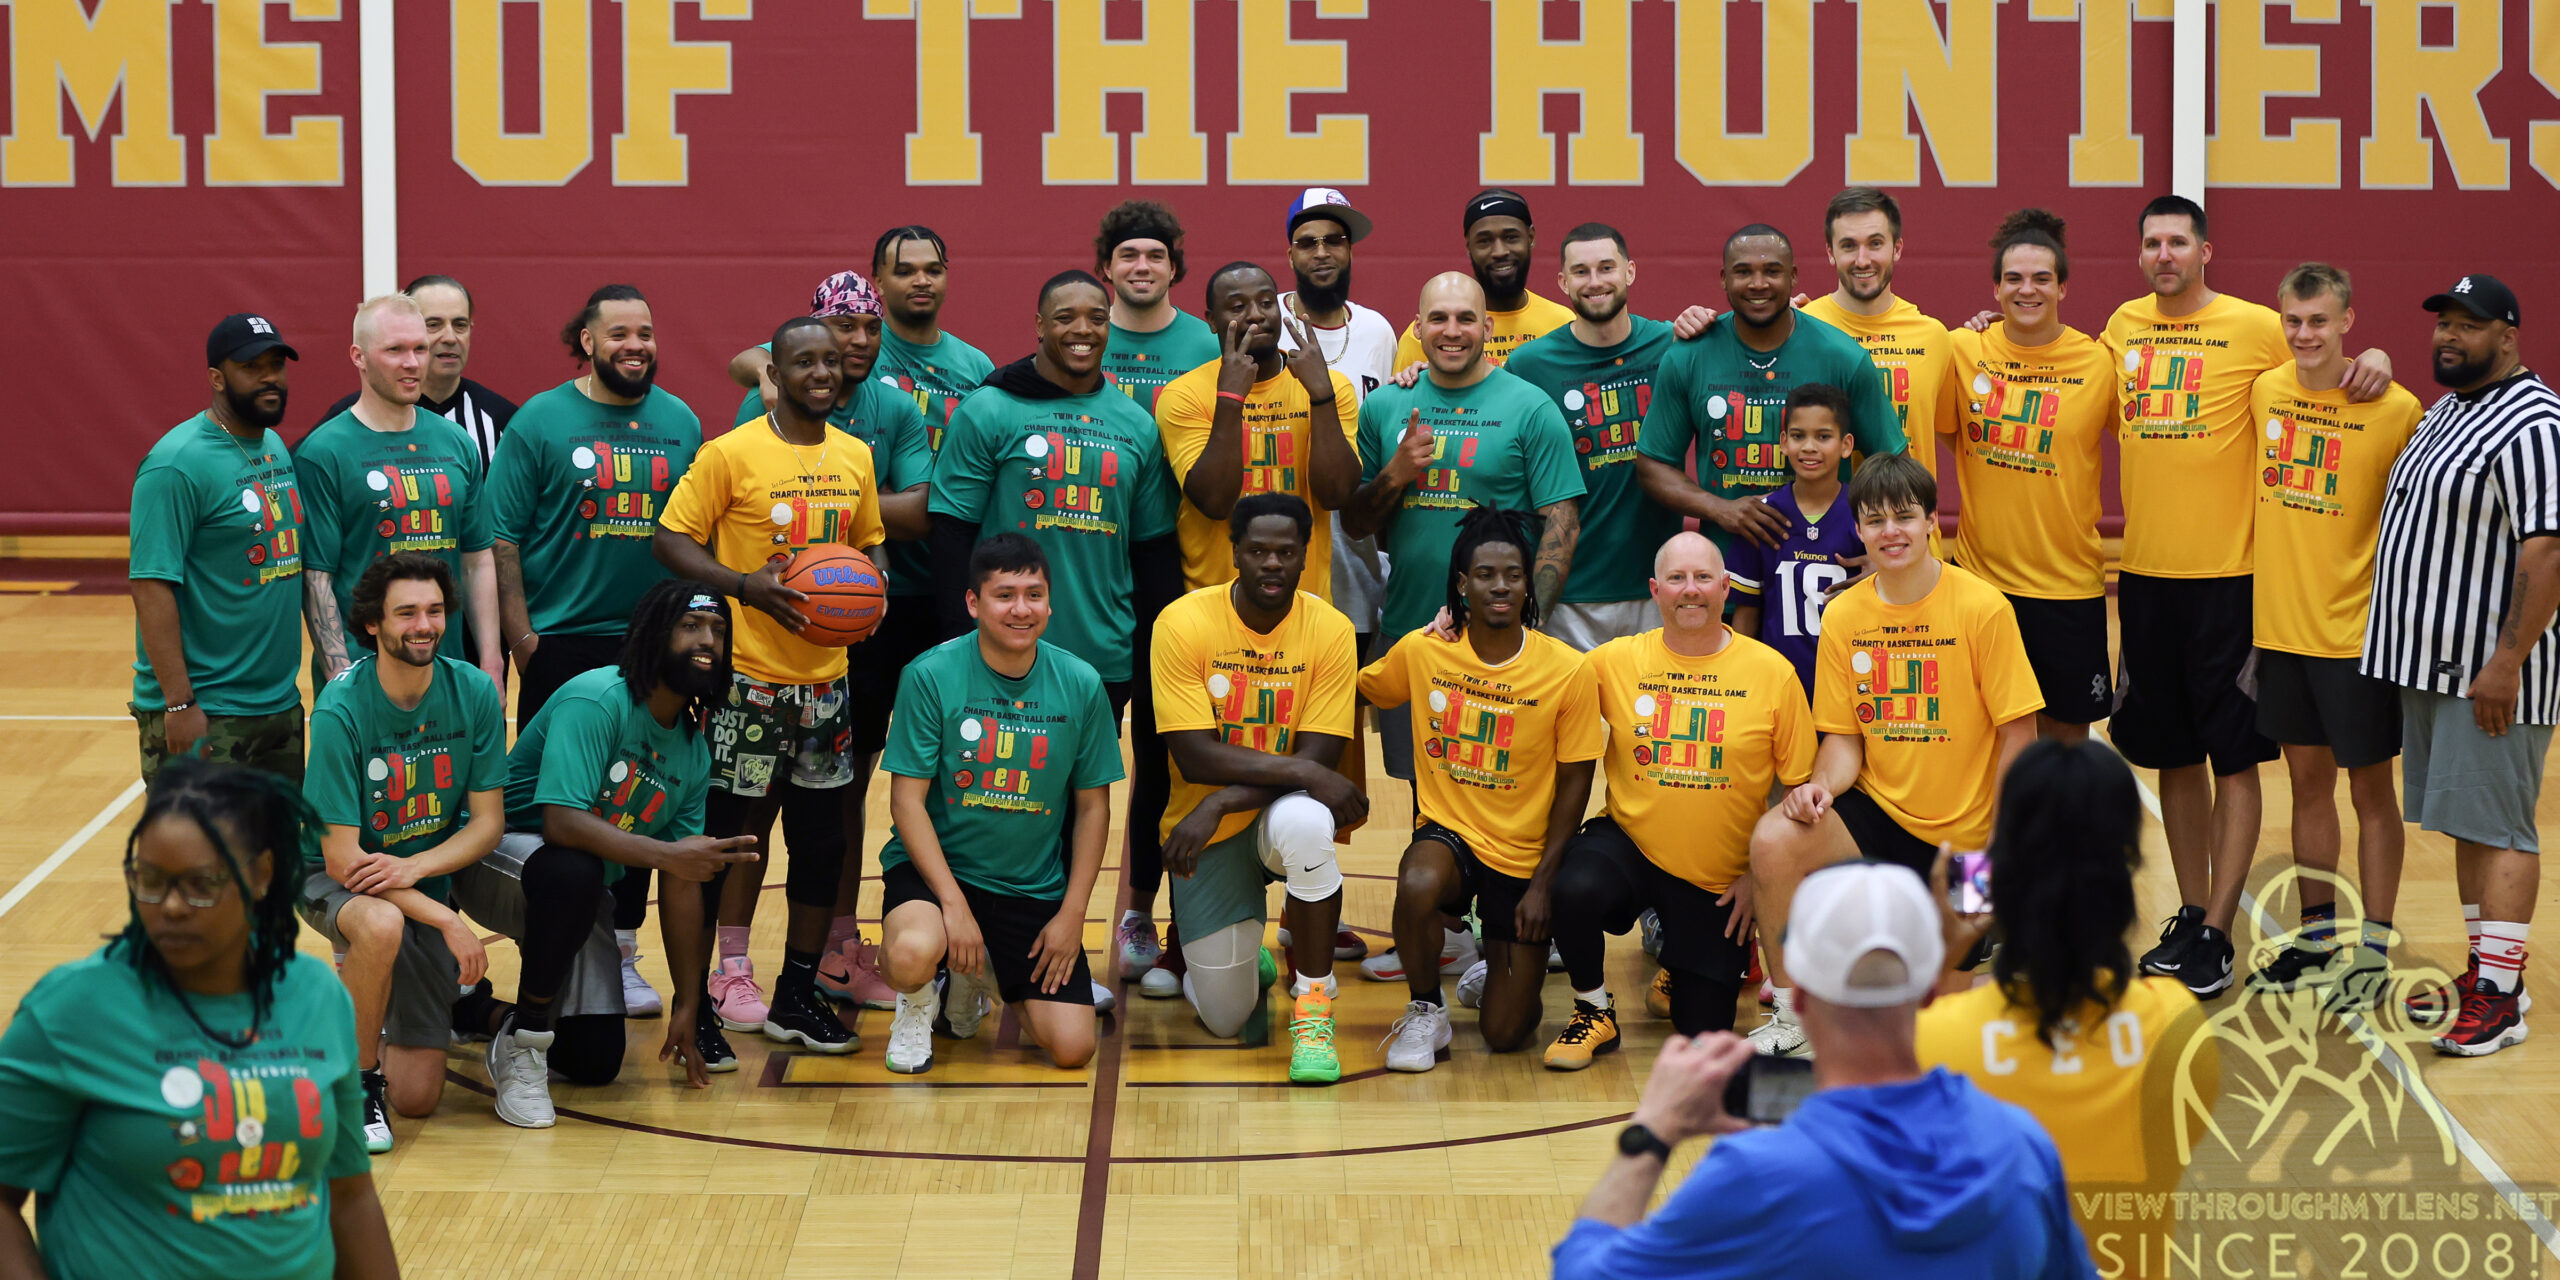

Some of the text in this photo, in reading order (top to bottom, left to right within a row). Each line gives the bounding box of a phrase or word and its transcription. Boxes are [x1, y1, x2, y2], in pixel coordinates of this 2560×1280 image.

[451, 0, 753, 187] OF
[863, 0, 1369, 185] THE
[1480, 0, 2560, 190] HUNTER
[2454, 277, 2473, 294] LA
[2152, 323, 2169, 332] TWIN
[2126, 337, 2230, 348] CHARITY BASKETBALL GAME
[1868, 348, 1925, 356] KETBALL GAME
[1116, 366, 1165, 375] BASKETBALL
[2005, 361, 2021, 369] TWIN
[1118, 377, 1167, 385] Celebrate
[1600, 378, 1648, 391] Celebrate
[2007, 374, 2085, 386] BASKETBALL GAME
[1746, 397, 1786, 405] Celebra
[2293, 399, 2309, 408] TWIN
[1288, 410, 1309, 419] GAME
[1431, 406, 1449, 415] TWIN
[1053, 412, 1073, 421] TWIN
[2268, 406, 2366, 431] CHARITY BASKETBALL GAME
[1433, 418, 1503, 428] BASKETBALL GAME
[1024, 424, 1133, 446] CHARITY BASKETBALL GAME
[1434, 429, 1479, 437] Celebrate
[1066, 438, 1116, 450] Celebrate
[1605, 445, 1638, 454] Freedo
[613, 446, 665, 455] Celebrate
[400, 467, 444, 475] Celebrate
[770, 490, 803, 499] CHARITY
[805, 489, 848, 497] BASKETBALL
[1420, 491, 1457, 499] Freedom
[1057, 510, 1100, 521] Freedom
[609, 518, 651, 527] Freedom
[812, 566, 878, 588] Wilson
[693, 594, 712, 602] NIKE
[1775, 561, 1847, 636] 18
[1882, 626, 1899, 634] TWIN
[1852, 637, 1957, 648] CHARITY BASKETBALL GAME
[1212, 660, 1245, 673] CHARITY
[1462, 674, 1481, 686] TWIN
[1666, 672, 1685, 680] TWIN
[1431, 677, 1539, 707] CHARITY BASKETBALL GAME
[1638, 682, 1747, 698] CHARITY BASKETBALL GAME
[1465, 699, 1515, 715] Celebrate
[1674, 697, 1725, 708] Celebrate
[712, 707, 748, 730] JUST
[963, 706, 1068, 723] CHARITY BASKETBALL GAME
[714, 725, 738, 745] DO
[999, 724, 1047, 735] Celebrate
[715, 743, 733, 763] IT.
[1664, 772, 1692, 782] DIVERSITY
[1692, 775, 1703, 783] AND
[1703, 775, 1730, 784] INCLUSION
[984, 791, 1026, 801] Freedom
[1981, 1011, 2144, 1076] CEO
